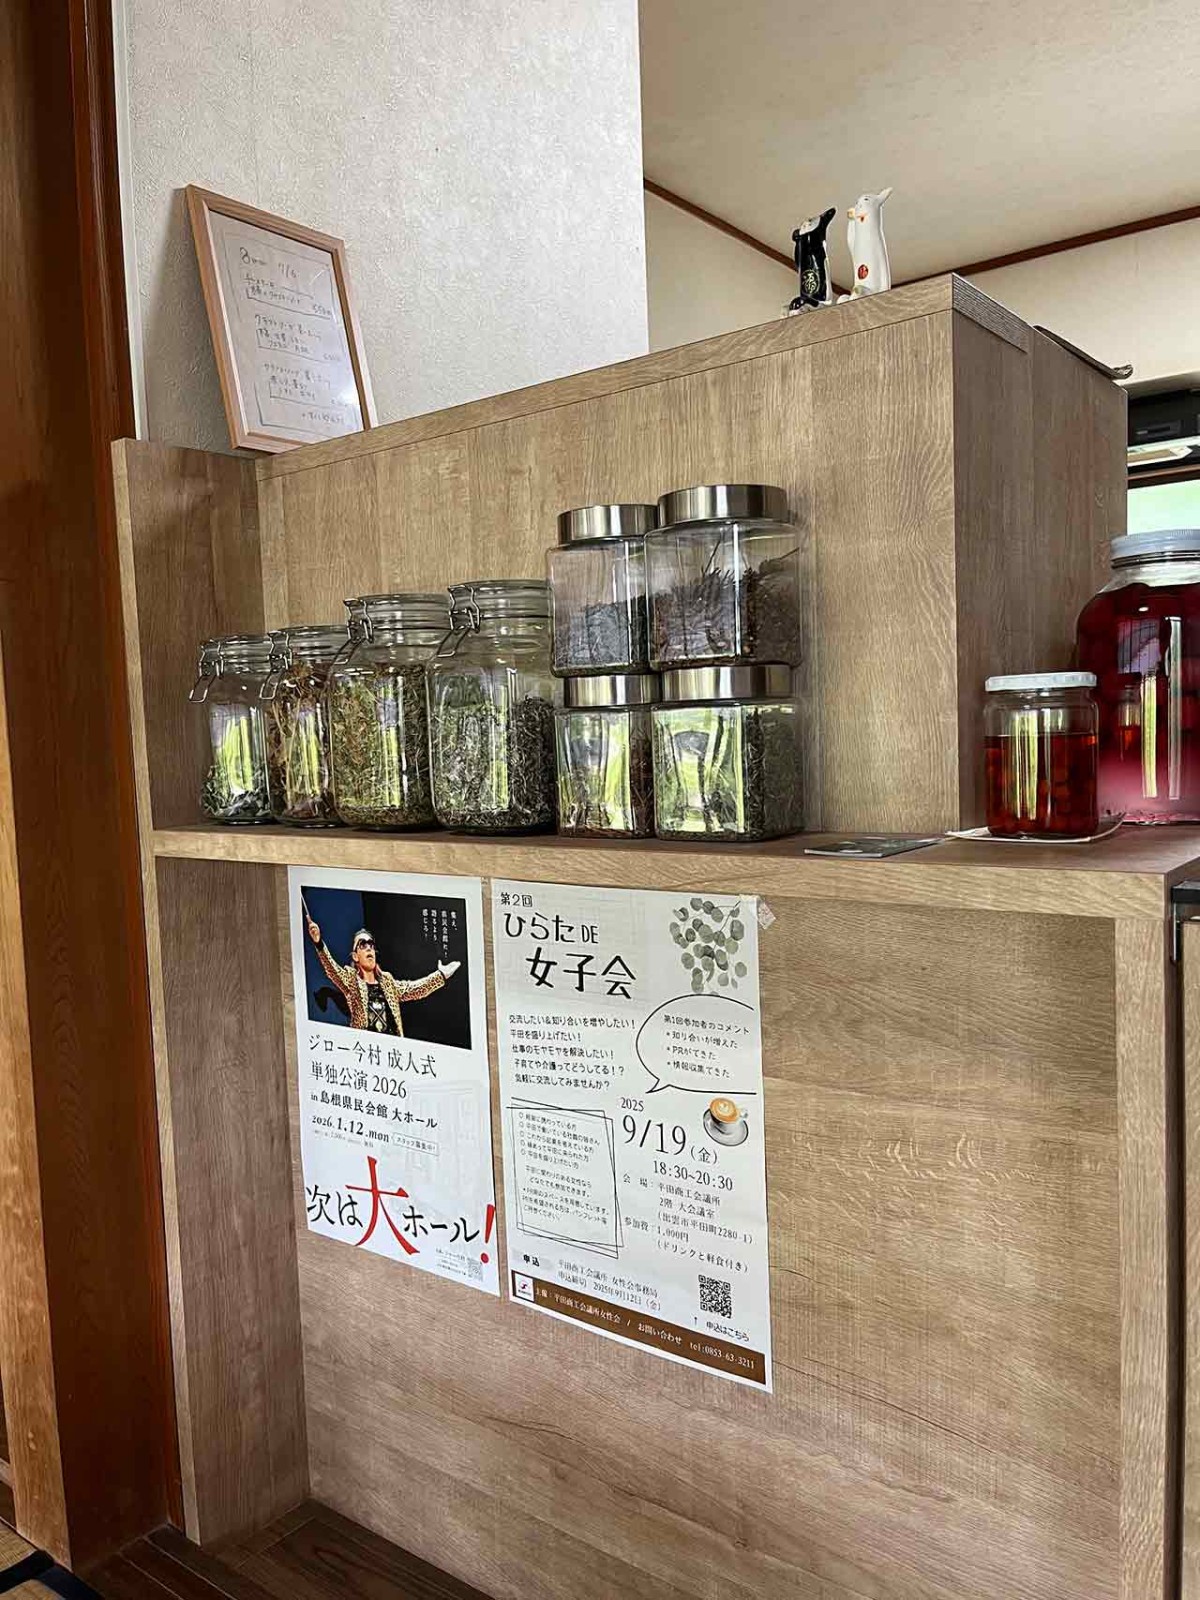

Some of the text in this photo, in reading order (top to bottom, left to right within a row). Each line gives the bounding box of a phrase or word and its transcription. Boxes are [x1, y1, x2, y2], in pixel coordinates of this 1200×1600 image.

[500, 892, 533, 907] 第2回
[525, 946, 637, 999] 女子会
[664, 1014, 750, 1035] 第1回参加者のコメント
[510, 1029, 582, 1042] 平田を盛り上げたい！
[308, 1033, 437, 1079] ジロー今村 成人式
[512, 1044, 614, 1060] 仕事のモヤモヤを解決したい！
[308, 1060, 407, 1099] 単独公演 2026
[515, 1073, 610, 1090] 気軽に交流してみませんか？
[310, 1090, 438, 1128] in 島根県民会館 大ホール
[621, 1096, 645, 1112] 2025
[659, 1182, 721, 1207] 平田商工会議所
[523, 1254, 540, 1267] 申込
[638, 1322, 683, 1345] お問い合わせ
[706, 1320, 750, 1342] 申込はこちら
